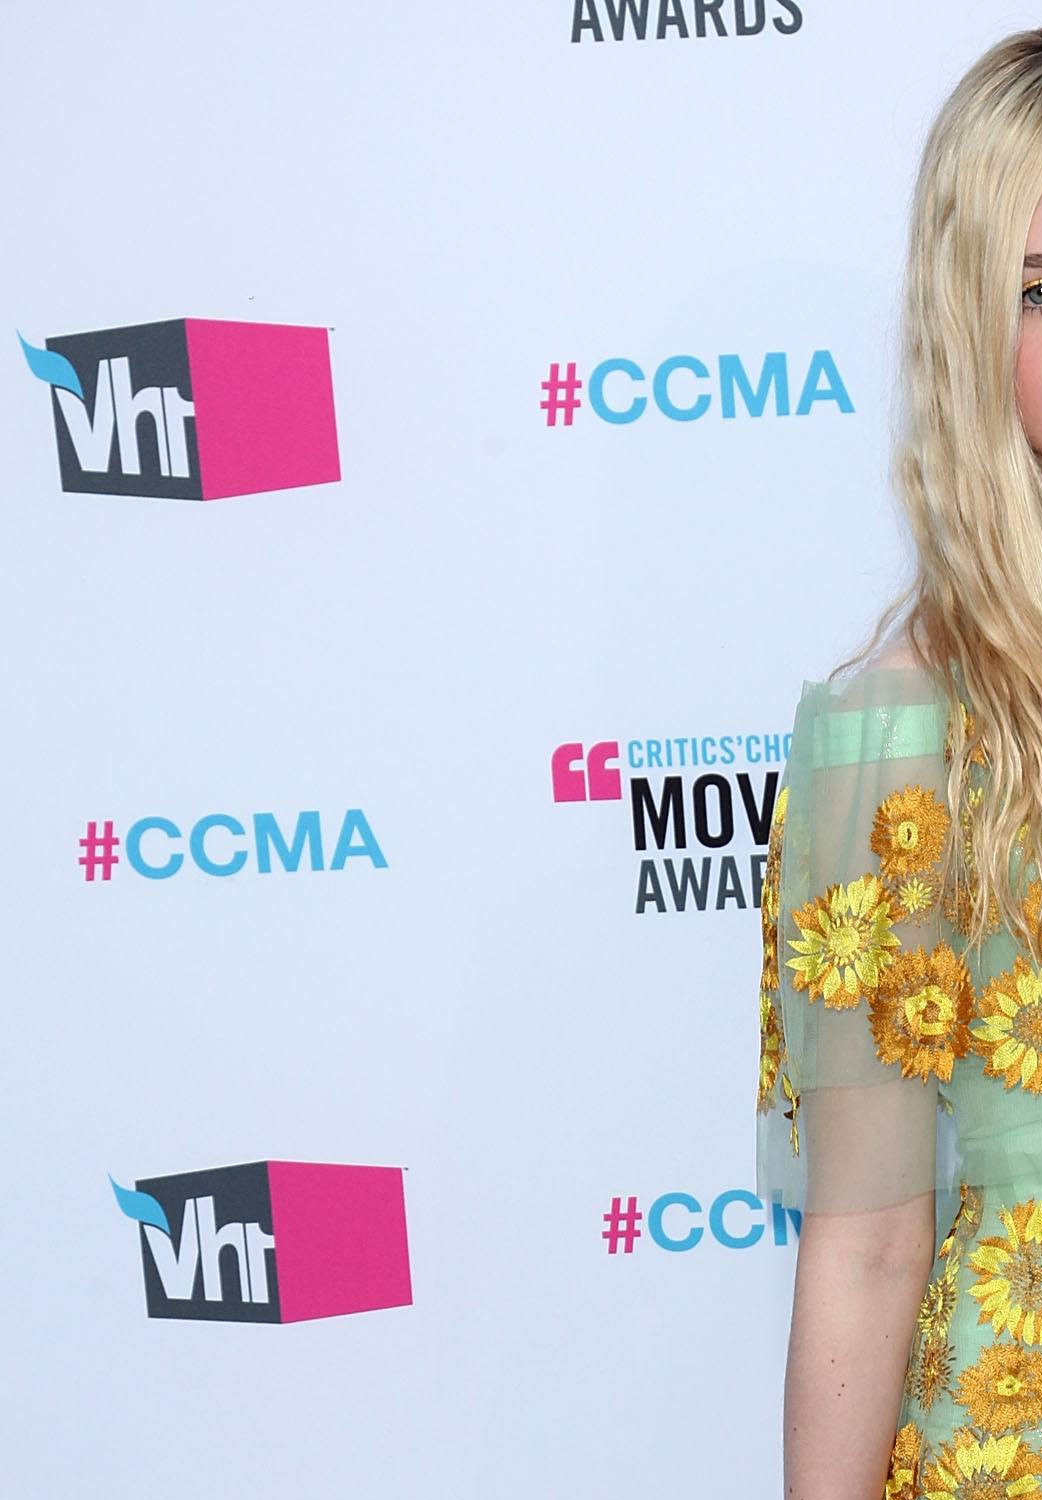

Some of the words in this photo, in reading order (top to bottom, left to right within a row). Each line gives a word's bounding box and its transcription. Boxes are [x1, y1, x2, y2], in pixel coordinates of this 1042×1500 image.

[571, 0, 804, 44] AWARDS
[540, 350, 856, 428] #CCMA
[79, 808, 390, 883] #CCMA
